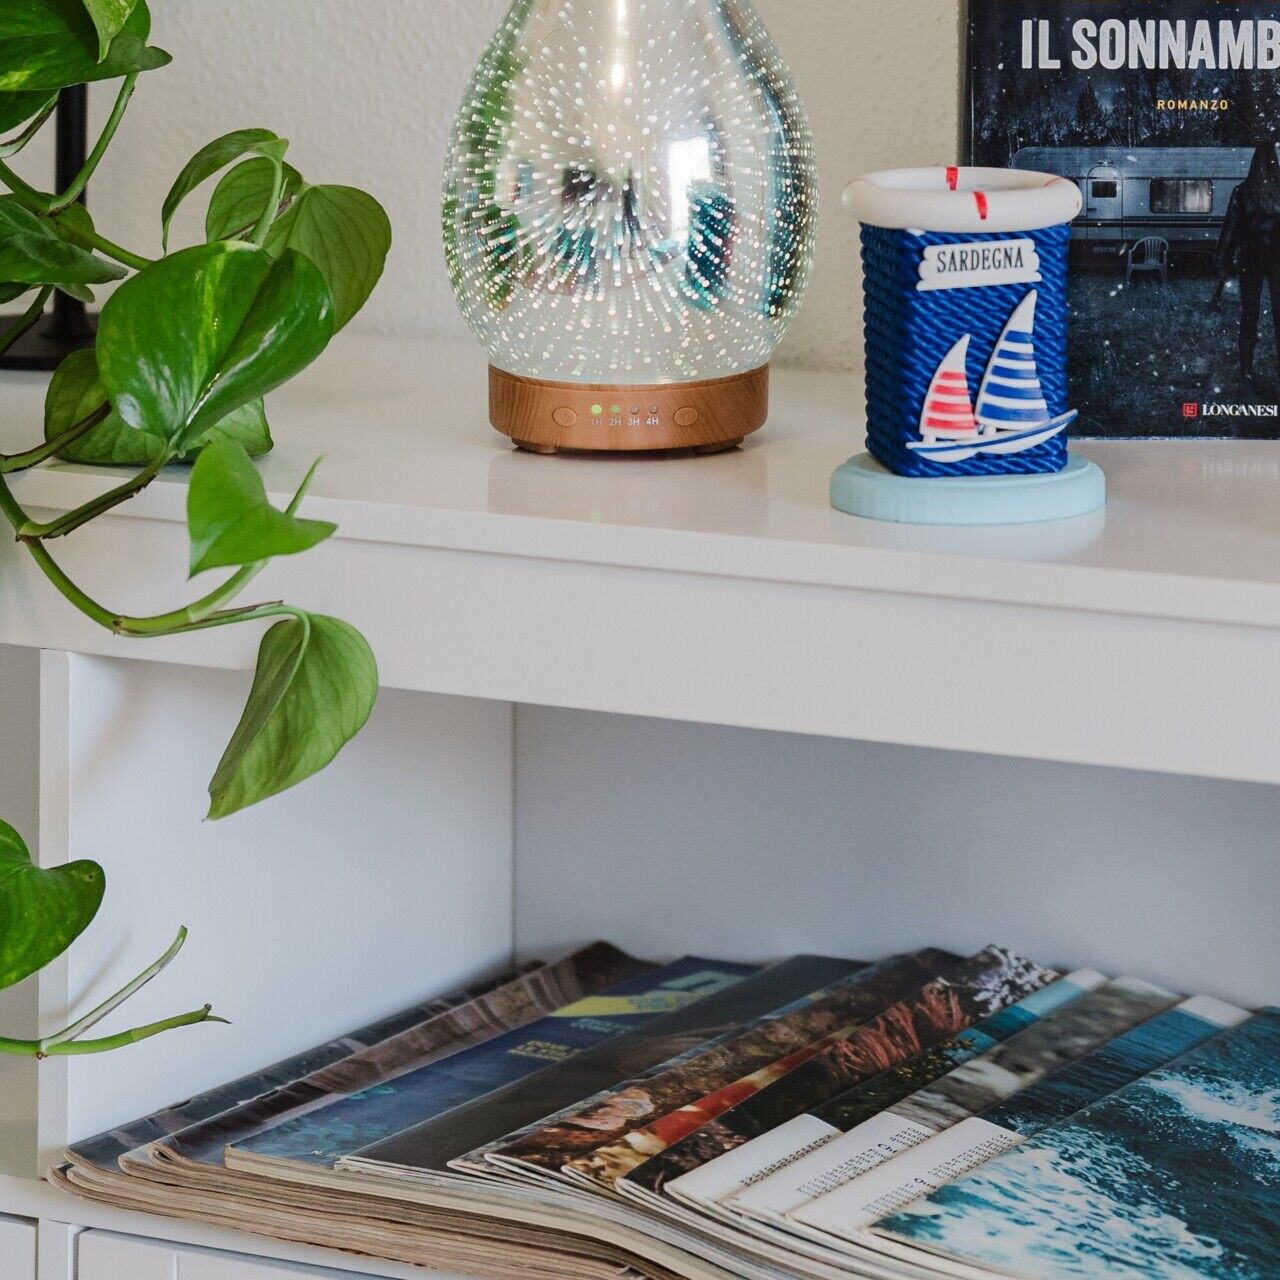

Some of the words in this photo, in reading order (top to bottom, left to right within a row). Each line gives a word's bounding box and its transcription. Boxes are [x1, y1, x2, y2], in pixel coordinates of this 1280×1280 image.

[1020, 18, 1061, 70] IL
[1157, 99, 1228, 110] ROMANZO
[936, 246, 1024, 273] SARDEGNA
[1202, 403, 1278, 417] LONGANESI
[609, 417, 622, 426] 2H
[627, 417, 640, 426] 3H
[646, 417, 659, 426] 4H
